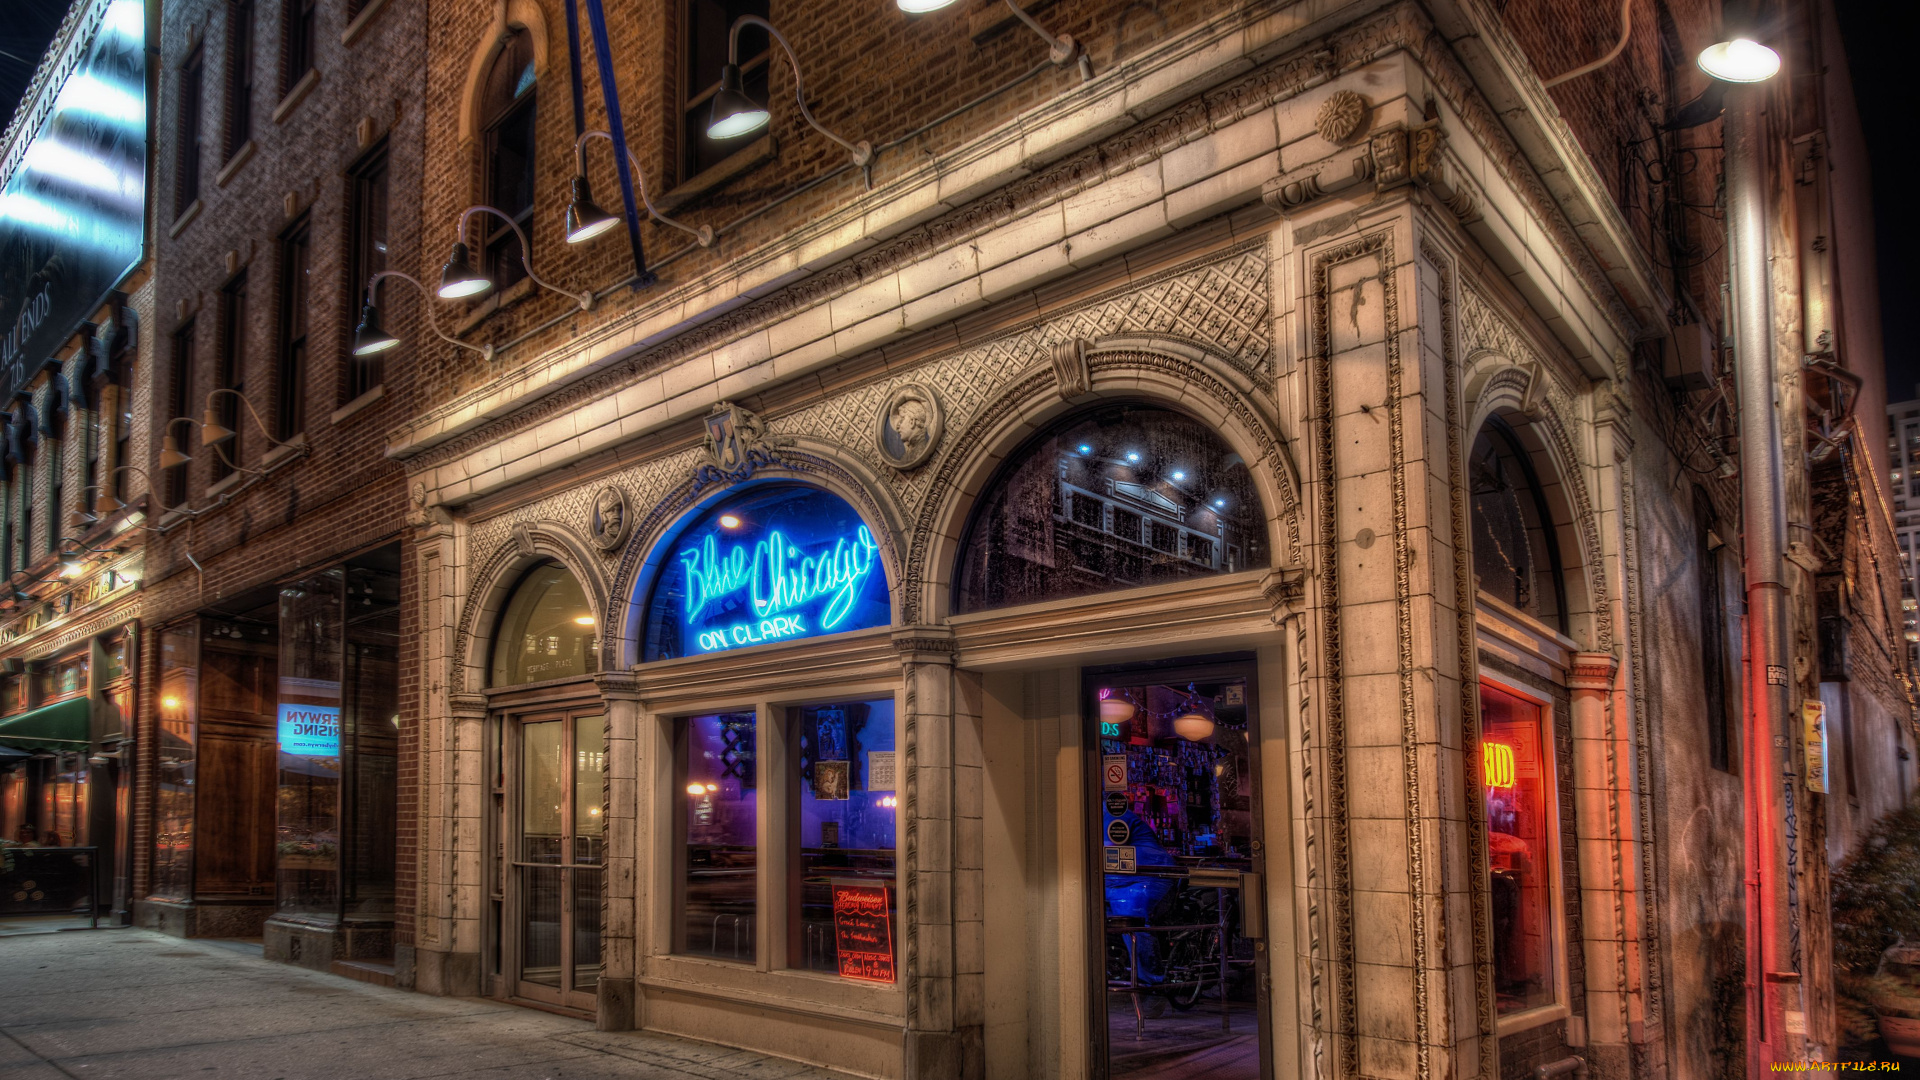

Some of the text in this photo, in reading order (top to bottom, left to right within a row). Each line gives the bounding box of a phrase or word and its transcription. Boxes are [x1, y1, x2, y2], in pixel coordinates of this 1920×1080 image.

[1, 282, 50, 371] ALL ENDS
[680, 525, 877, 629] Blue Chicago
[698, 614, 806, 651] ON CLARK
[837, 891, 882, 903] Budweiser
